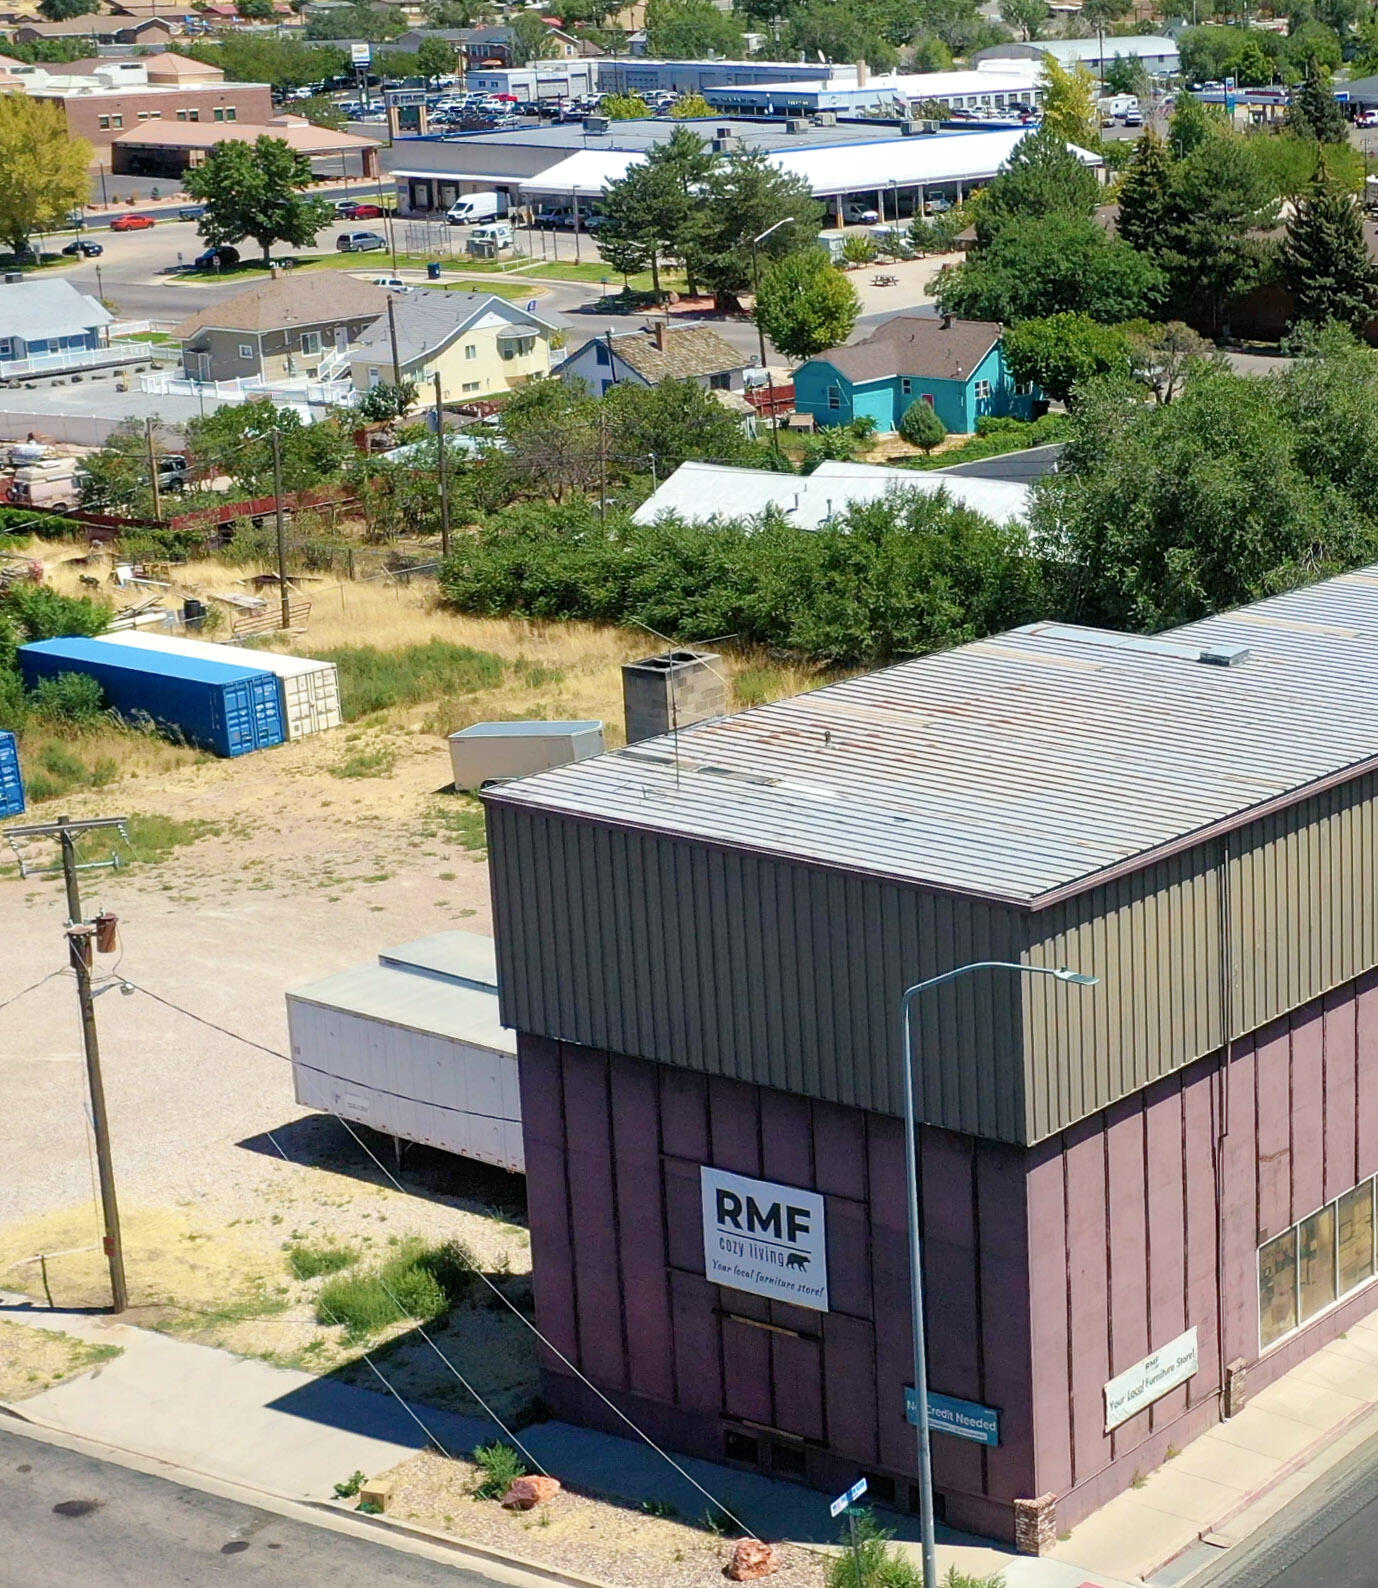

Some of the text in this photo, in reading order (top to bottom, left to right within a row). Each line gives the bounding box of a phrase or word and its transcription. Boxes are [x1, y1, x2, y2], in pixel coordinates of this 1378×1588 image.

[715, 1188, 811, 1243] RMF
[749, 1243, 784, 1268] living
[712, 1259, 825, 1297] Your local furniture store!
[1110, 1347, 1195, 1411] Your Local Furniture Store!
[956, 1413, 996, 1432] Needed
